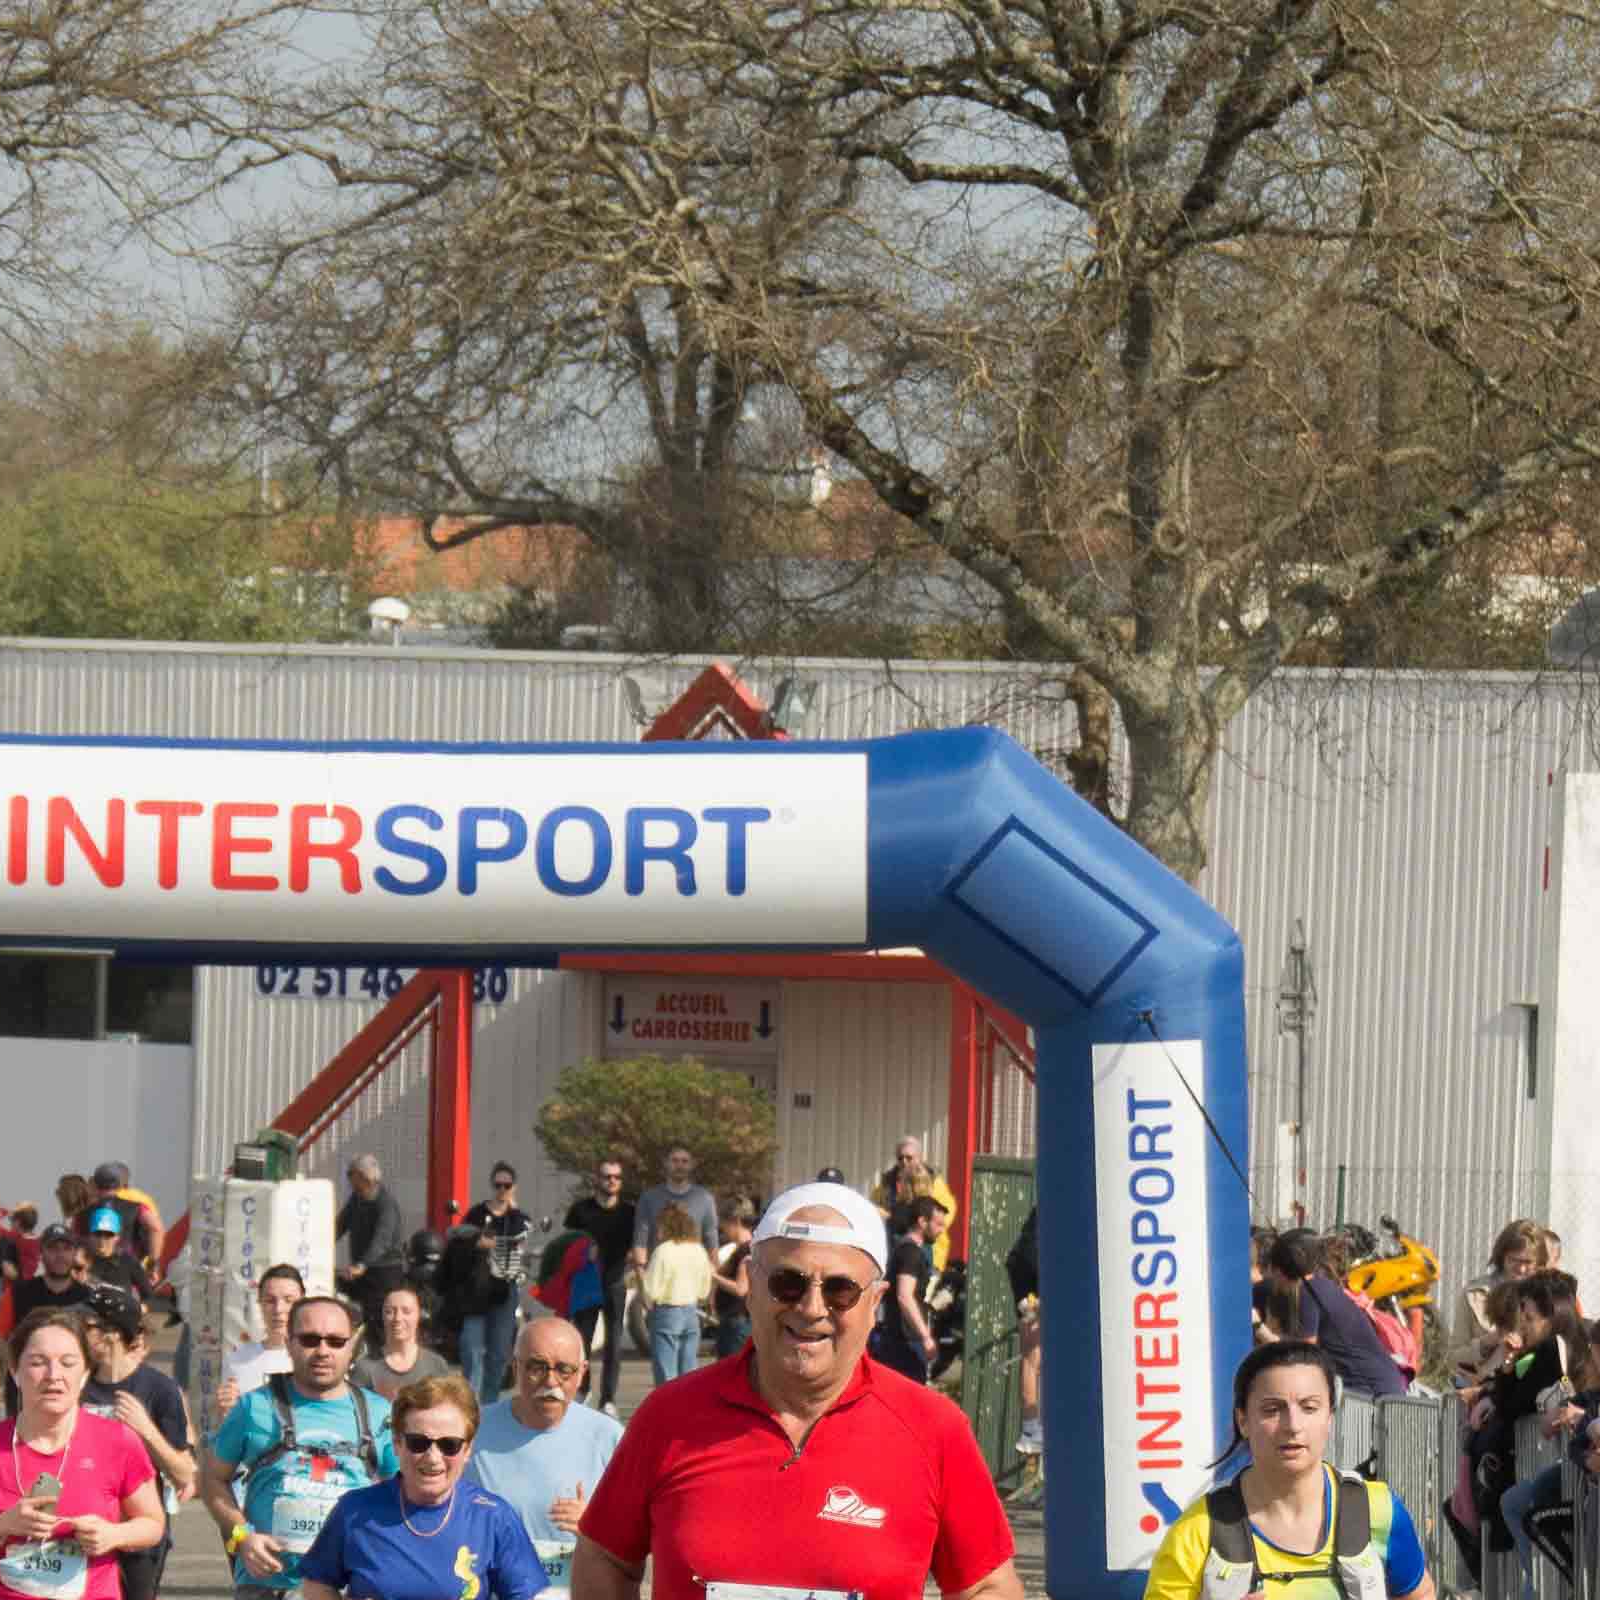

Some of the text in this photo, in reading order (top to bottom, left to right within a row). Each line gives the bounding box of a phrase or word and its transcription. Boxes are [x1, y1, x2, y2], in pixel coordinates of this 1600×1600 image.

[7, 795, 772, 898] INTERSPORT
[257, 966, 300, 995] 02
[655, 991, 729, 1016] ACCUEIL
[631, 1017, 752, 1042] CARROSSERIE
[1126, 1087, 1184, 1471] INTERSPORT
